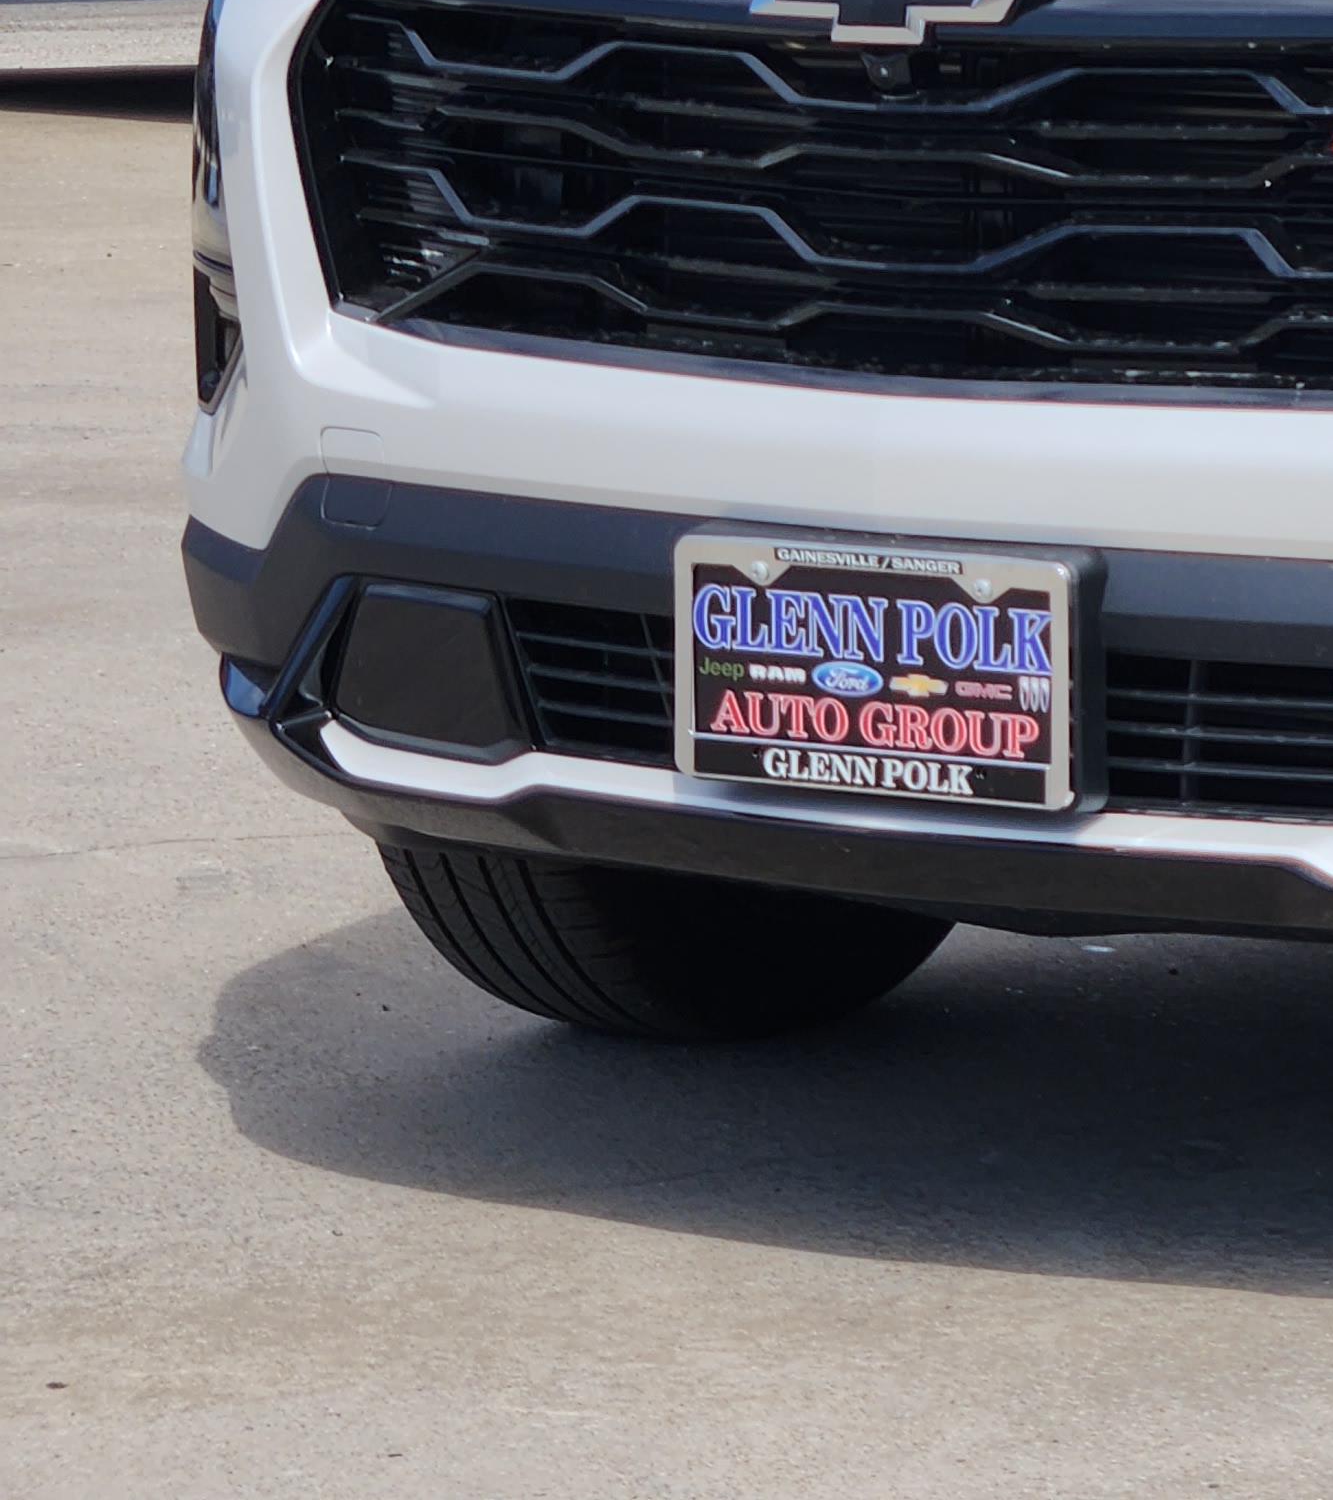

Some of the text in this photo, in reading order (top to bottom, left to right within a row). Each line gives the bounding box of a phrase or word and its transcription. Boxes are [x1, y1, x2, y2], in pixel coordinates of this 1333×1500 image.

[693, 583, 1052, 676] GLENN POLK
[698, 657, 1013, 700] Jeep RAM Ford GMC
[710, 689, 1040, 759] AUTO GROUP
[762, 747, 974, 796] GLENN POLK
